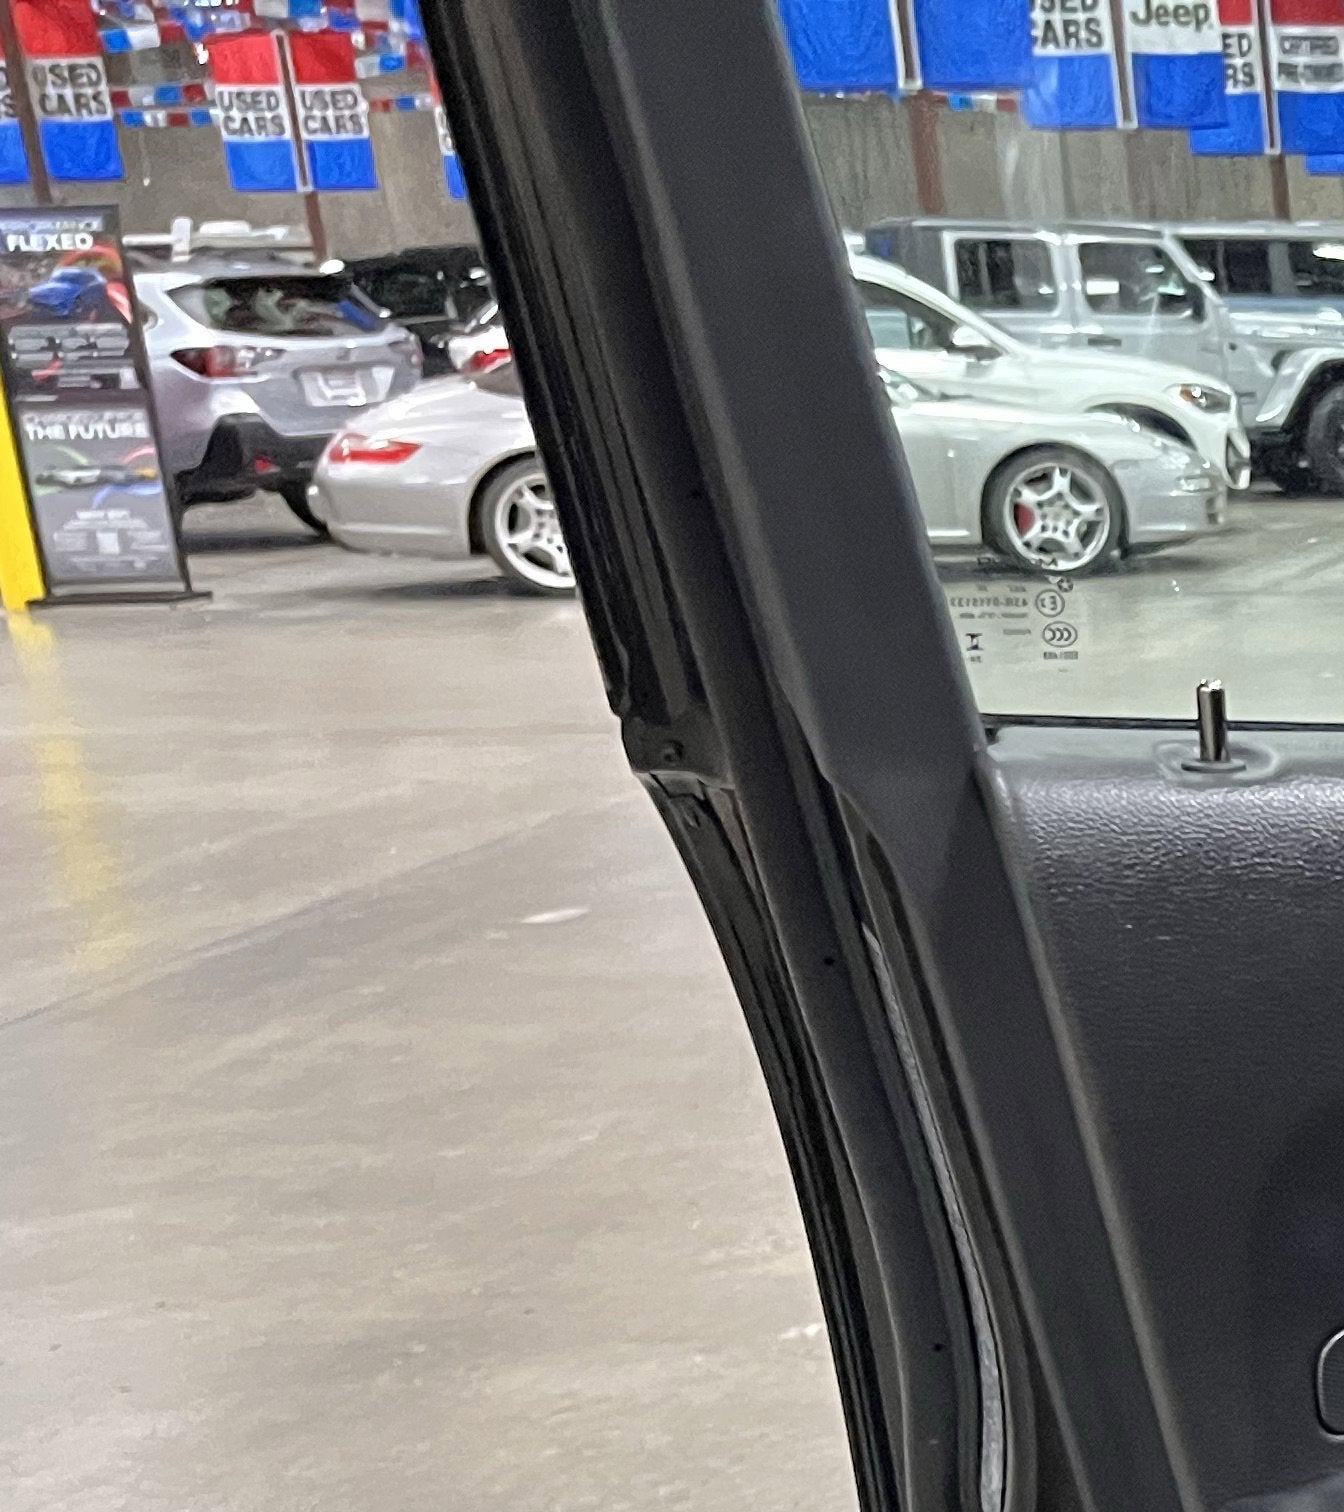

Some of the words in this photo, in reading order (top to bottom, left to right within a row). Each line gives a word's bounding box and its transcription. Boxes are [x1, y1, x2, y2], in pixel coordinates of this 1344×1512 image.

[1129, 0, 1211, 33] Jeep
[1032, 17, 1103, 49] ARS
[32, 63, 102, 88] USED
[39, 90, 108, 116] CARS
[217, 89, 280, 112] USED
[300, 89, 358, 112] USED
[222, 114, 286, 136] CARS
[303, 113, 364, 135] CARS
[7, 232, 94, 252] FLEXED
[68, 421, 148, 440] FUTURE
